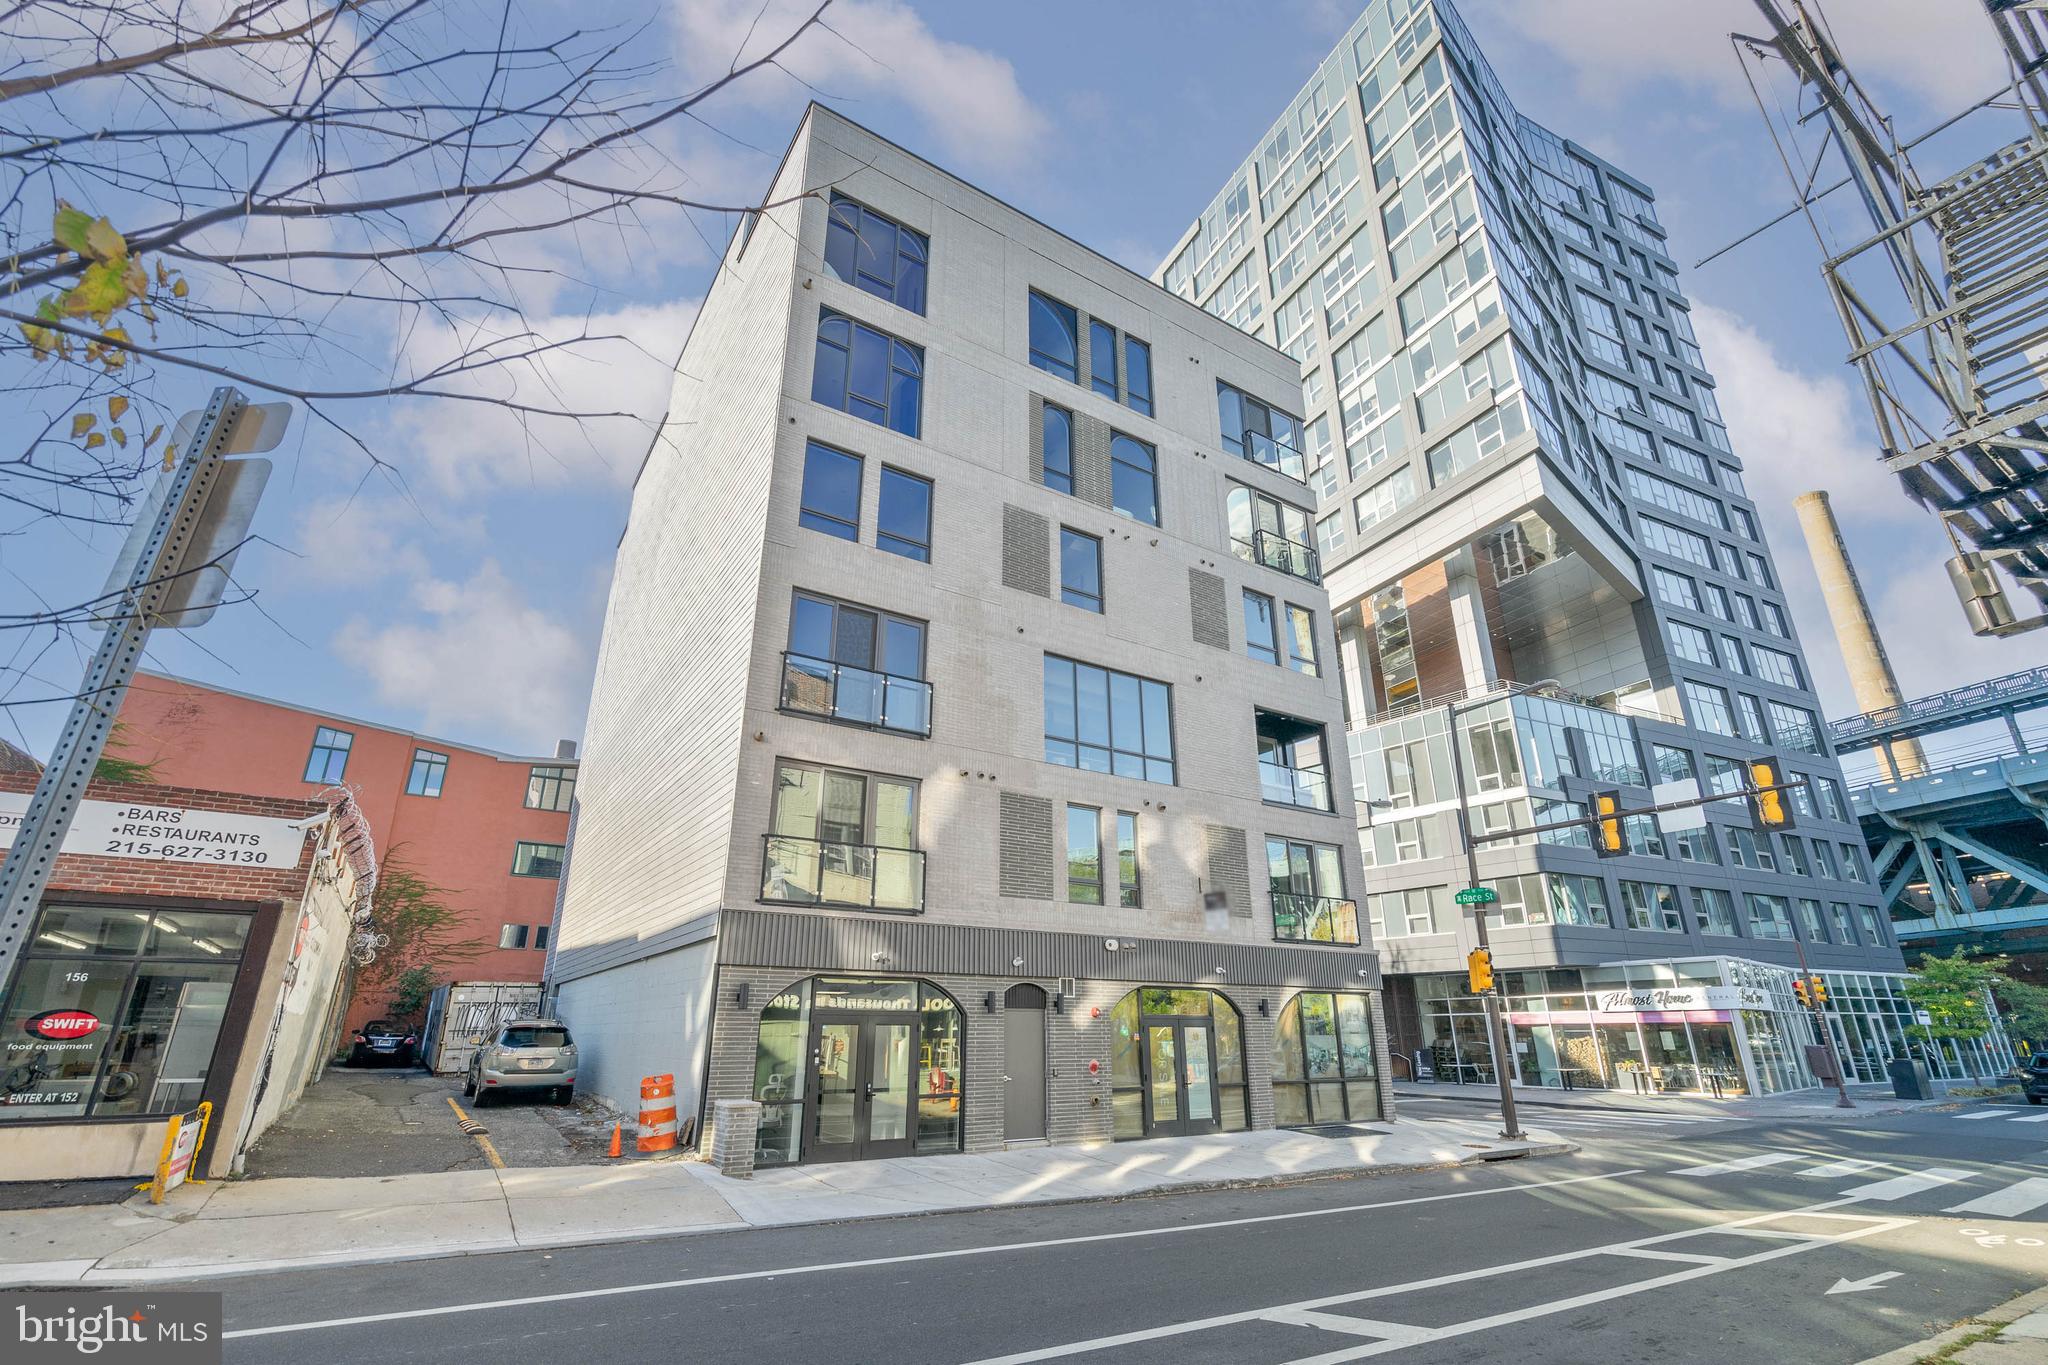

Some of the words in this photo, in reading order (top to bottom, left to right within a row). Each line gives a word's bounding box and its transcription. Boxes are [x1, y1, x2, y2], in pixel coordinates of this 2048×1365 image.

[128, 808, 182, 823] BARS
[122, 825, 260, 846] RESTAURANTS
[105, 840, 268, 865] 215-627-3130
[1463, 894, 1482, 902] Race
[65, 972, 89, 982] 156
[41, 1018, 97, 1030] SWIFT
[7, 1043, 32, 1051] food
[35, 1043, 93, 1052] equipment
[9, 1094, 43, 1104] ENTER
[44, 1093, 59, 1103] AT
[60, 1092, 79, 1103] 152
